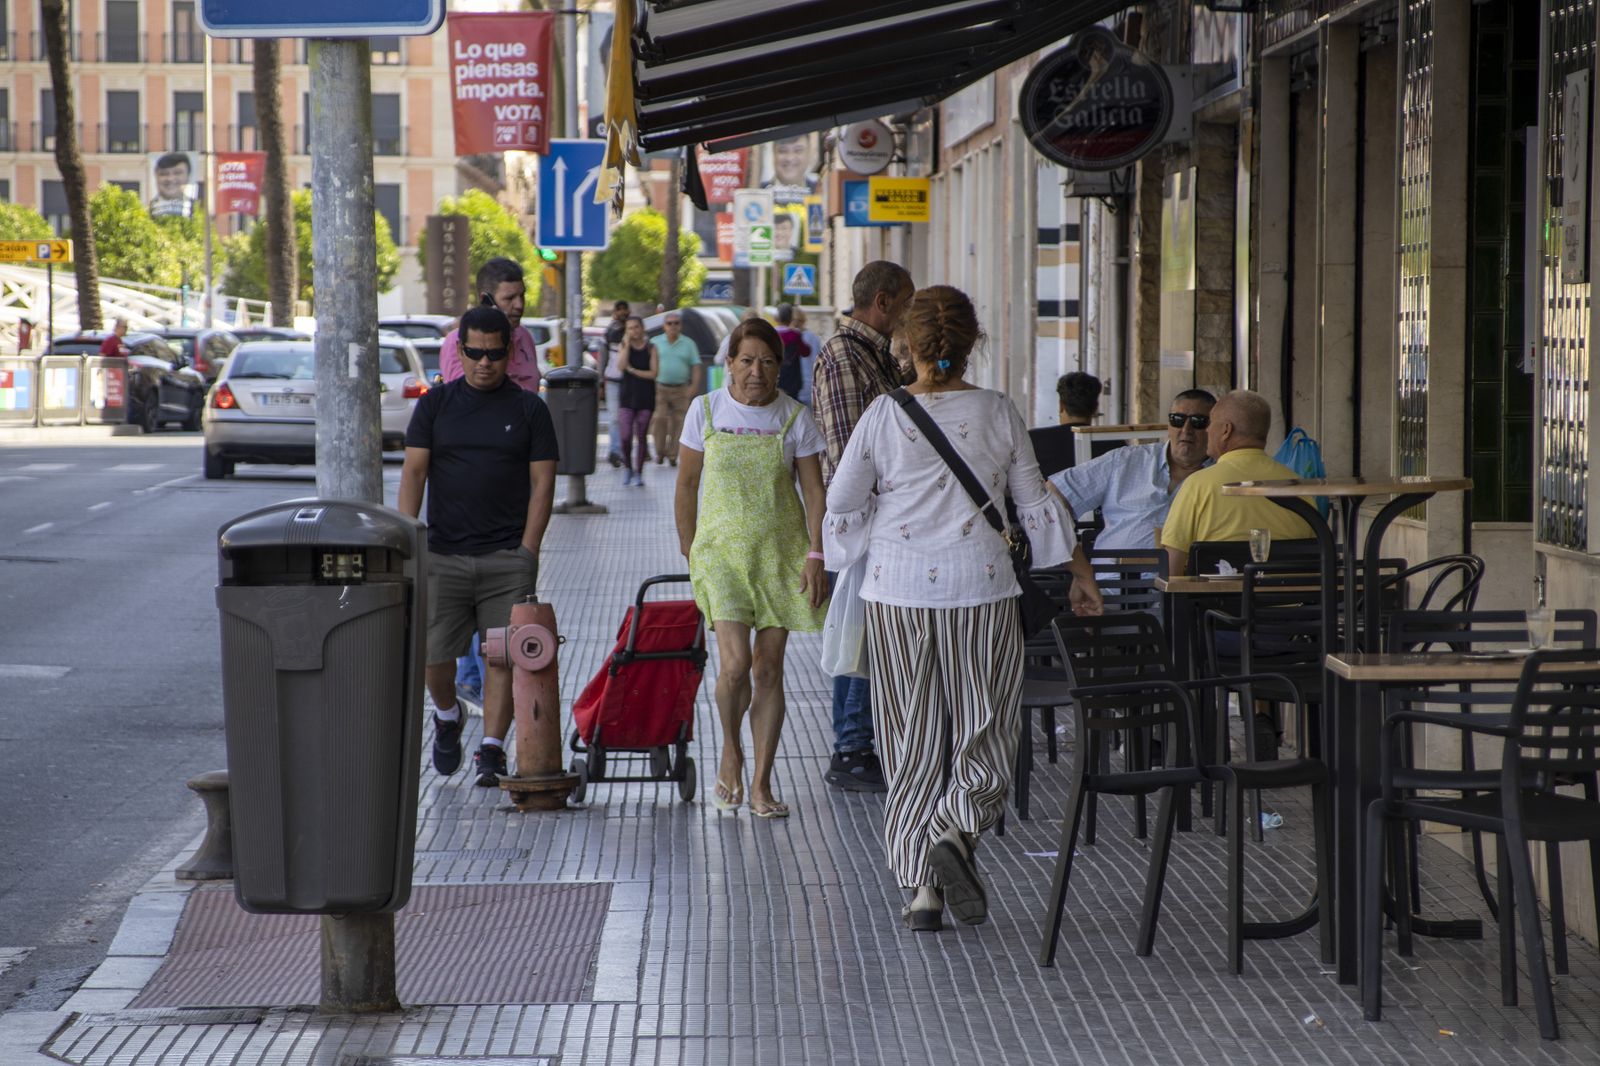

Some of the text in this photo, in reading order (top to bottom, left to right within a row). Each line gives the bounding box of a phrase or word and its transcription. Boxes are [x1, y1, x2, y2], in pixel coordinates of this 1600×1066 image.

[454, 40, 527, 61] Lo que
[455, 60, 539, 84] piensas
[456, 79, 545, 102] importa.
[1048, 75, 1146, 102] Estrella
[494, 104, 542, 120] VOTA
[1053, 101, 1144, 128] Galicia
